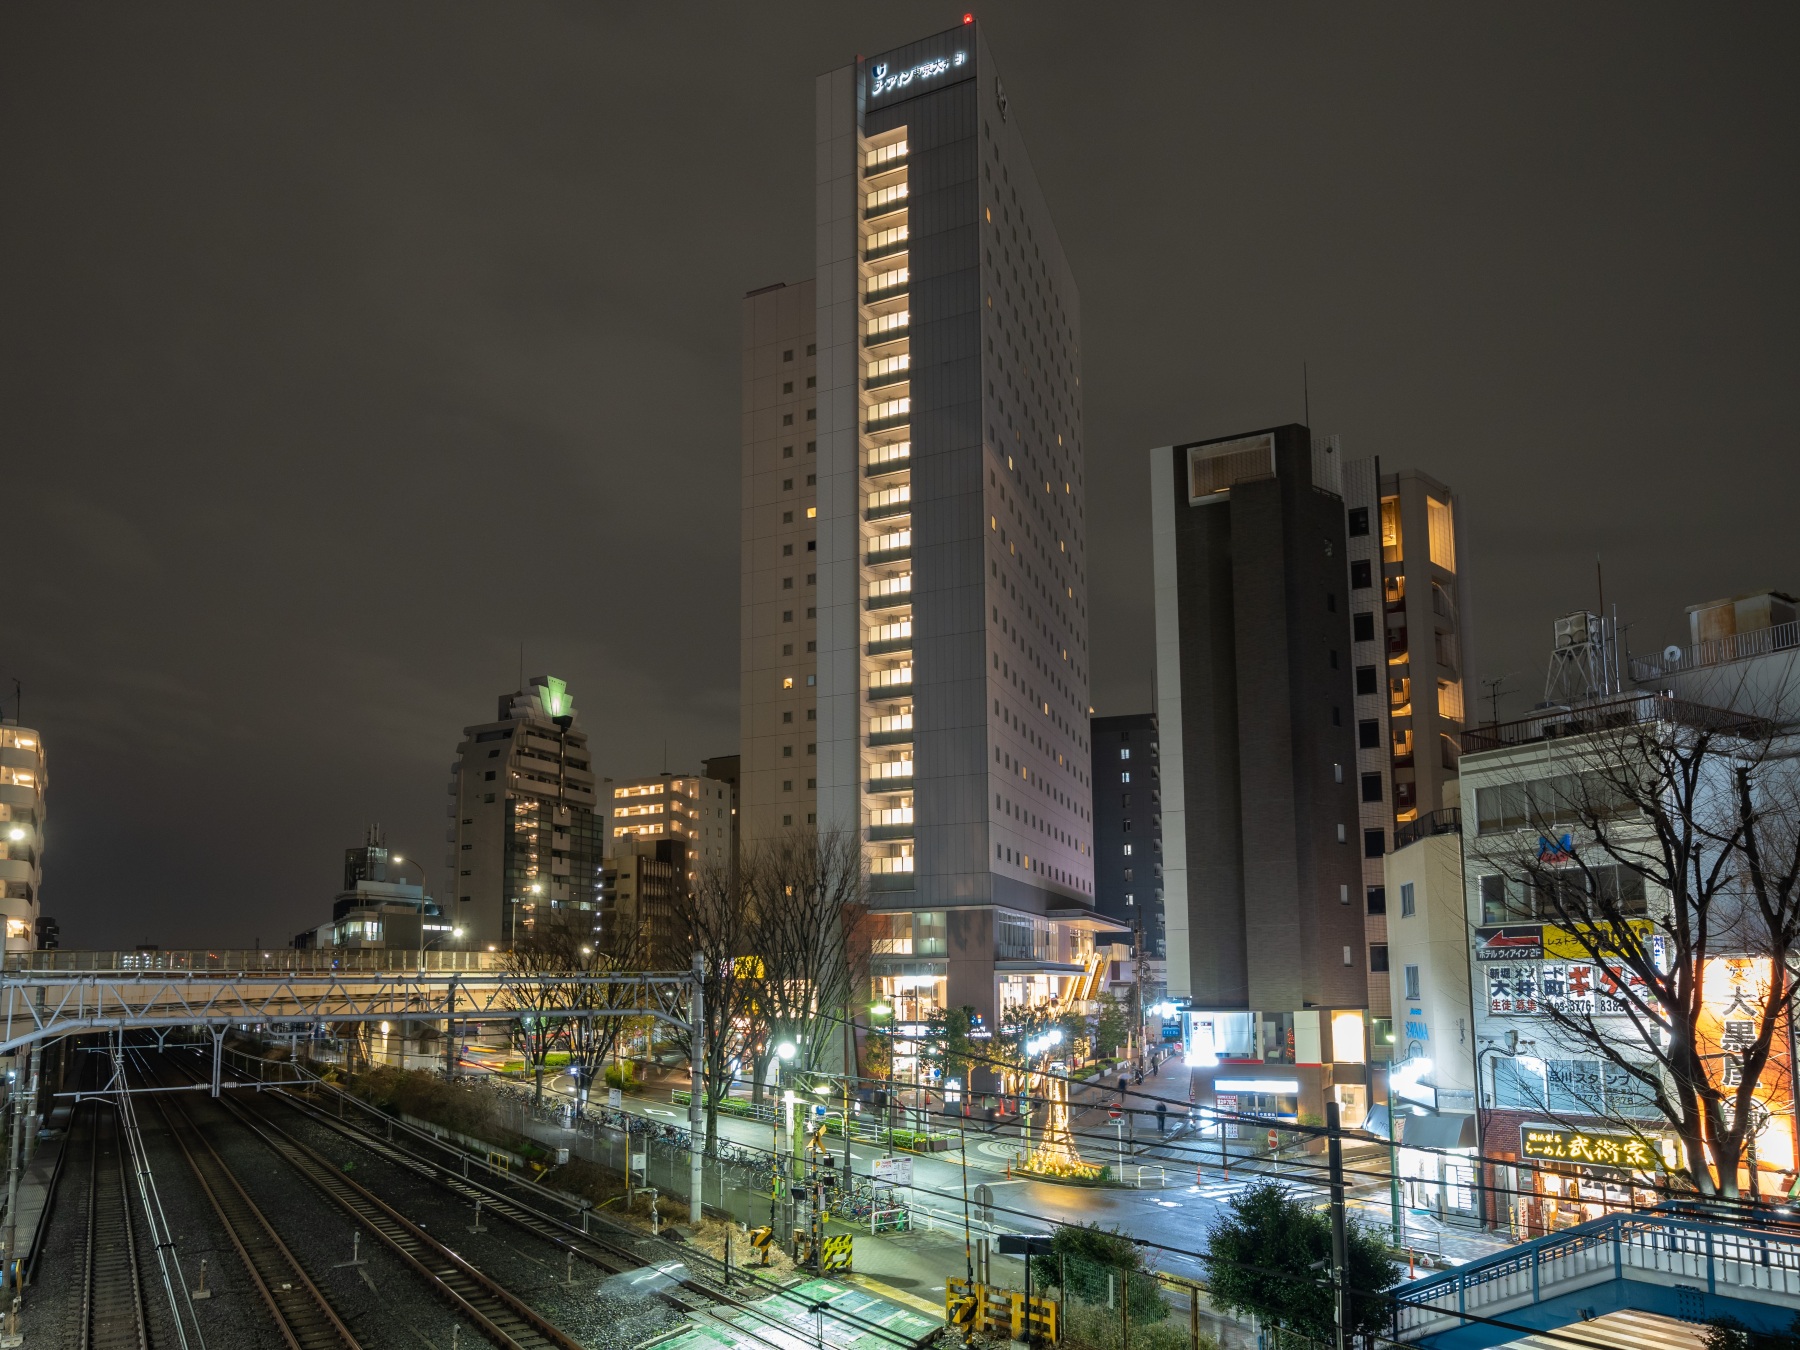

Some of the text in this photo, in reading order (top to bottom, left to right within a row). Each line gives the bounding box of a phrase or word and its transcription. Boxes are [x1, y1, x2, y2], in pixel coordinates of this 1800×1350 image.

[1479, 950, 1497, 958] ホテル
[1491, 979, 1565, 998] 大井町
[1492, 998, 1537, 1011] 生徒募集
[1525, 1135, 1650, 1165] らーめん 武術家
